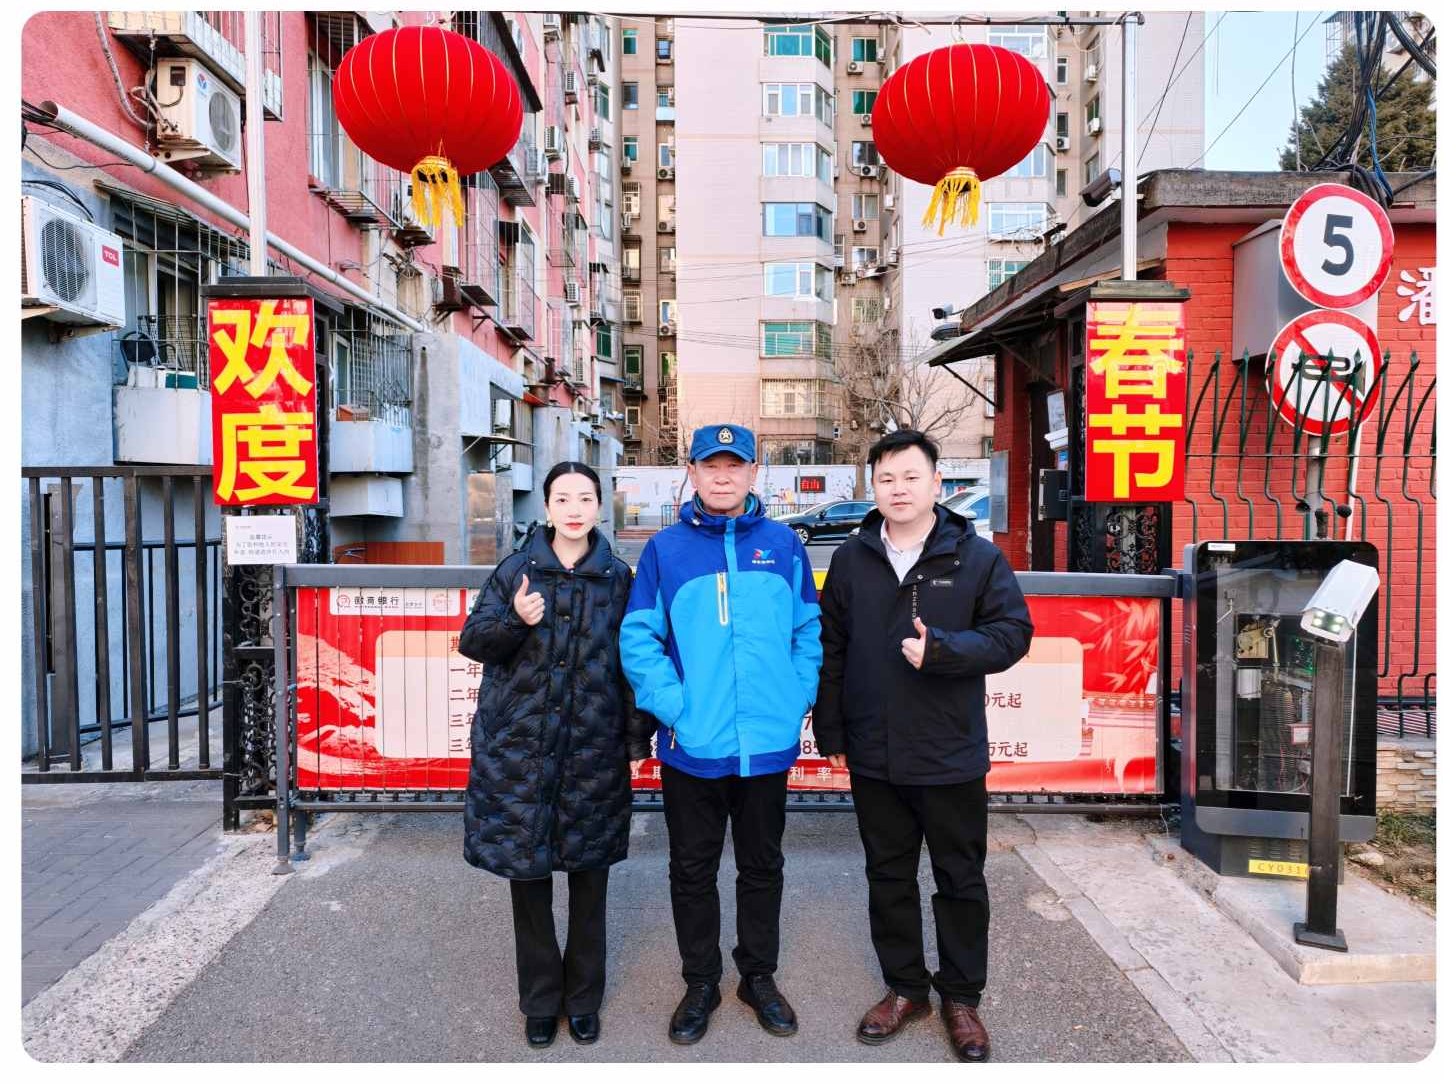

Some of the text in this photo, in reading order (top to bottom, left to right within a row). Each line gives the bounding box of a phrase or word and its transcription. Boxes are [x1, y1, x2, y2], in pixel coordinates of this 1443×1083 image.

[103, 249, 118, 262] TCL
[1321, 213, 1354, 276] 5
[211, 299, 317, 502] 欢度
[1088, 302, 1185, 499] 春节
